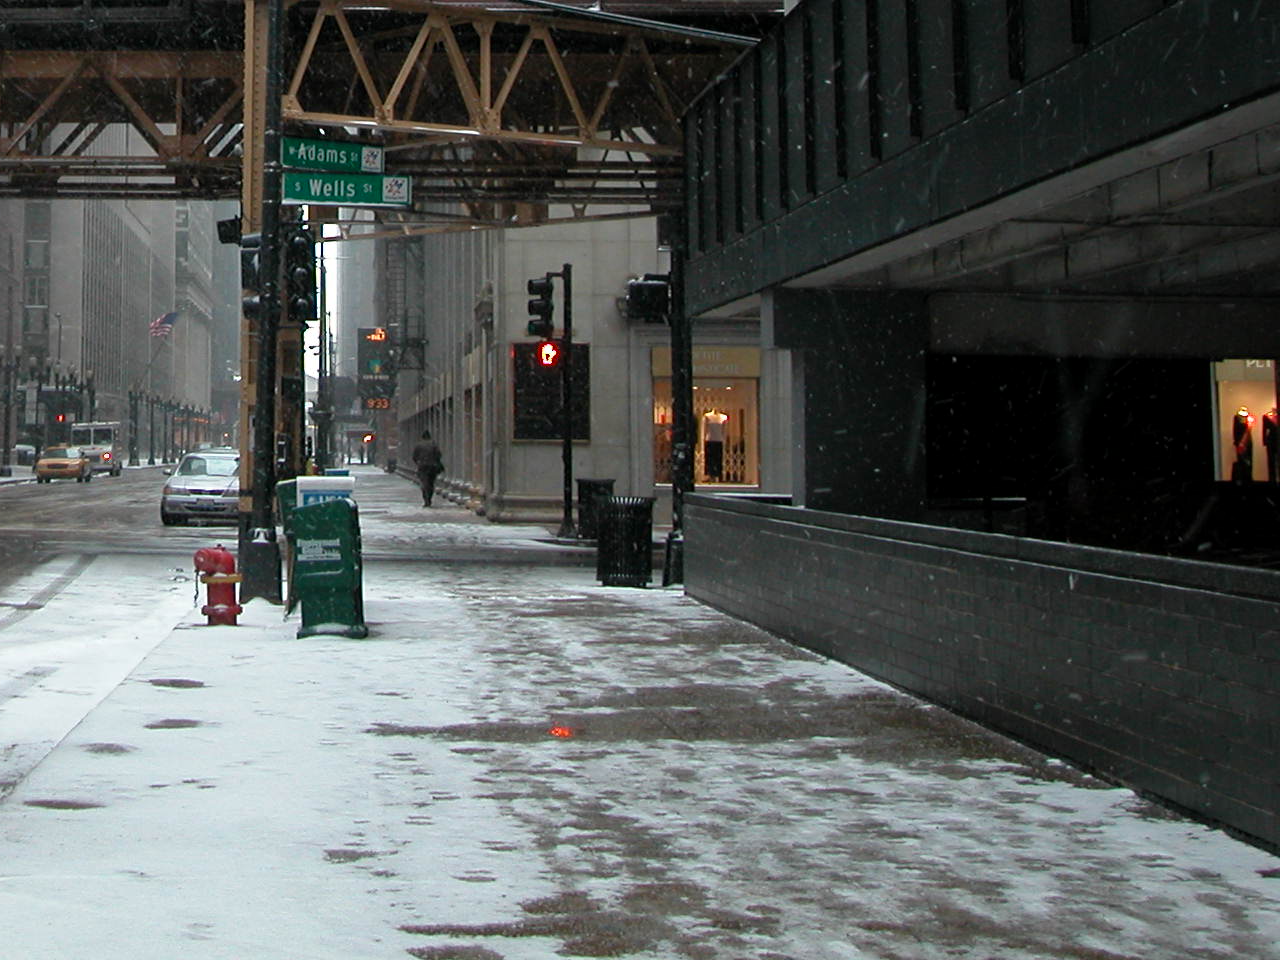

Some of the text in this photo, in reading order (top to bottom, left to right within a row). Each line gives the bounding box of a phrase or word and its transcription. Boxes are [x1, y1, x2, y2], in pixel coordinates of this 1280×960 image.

[297, 143, 347, 164] Adams
[350, 152, 358, 161] St
[295, 179, 373, 197] S Wells St
